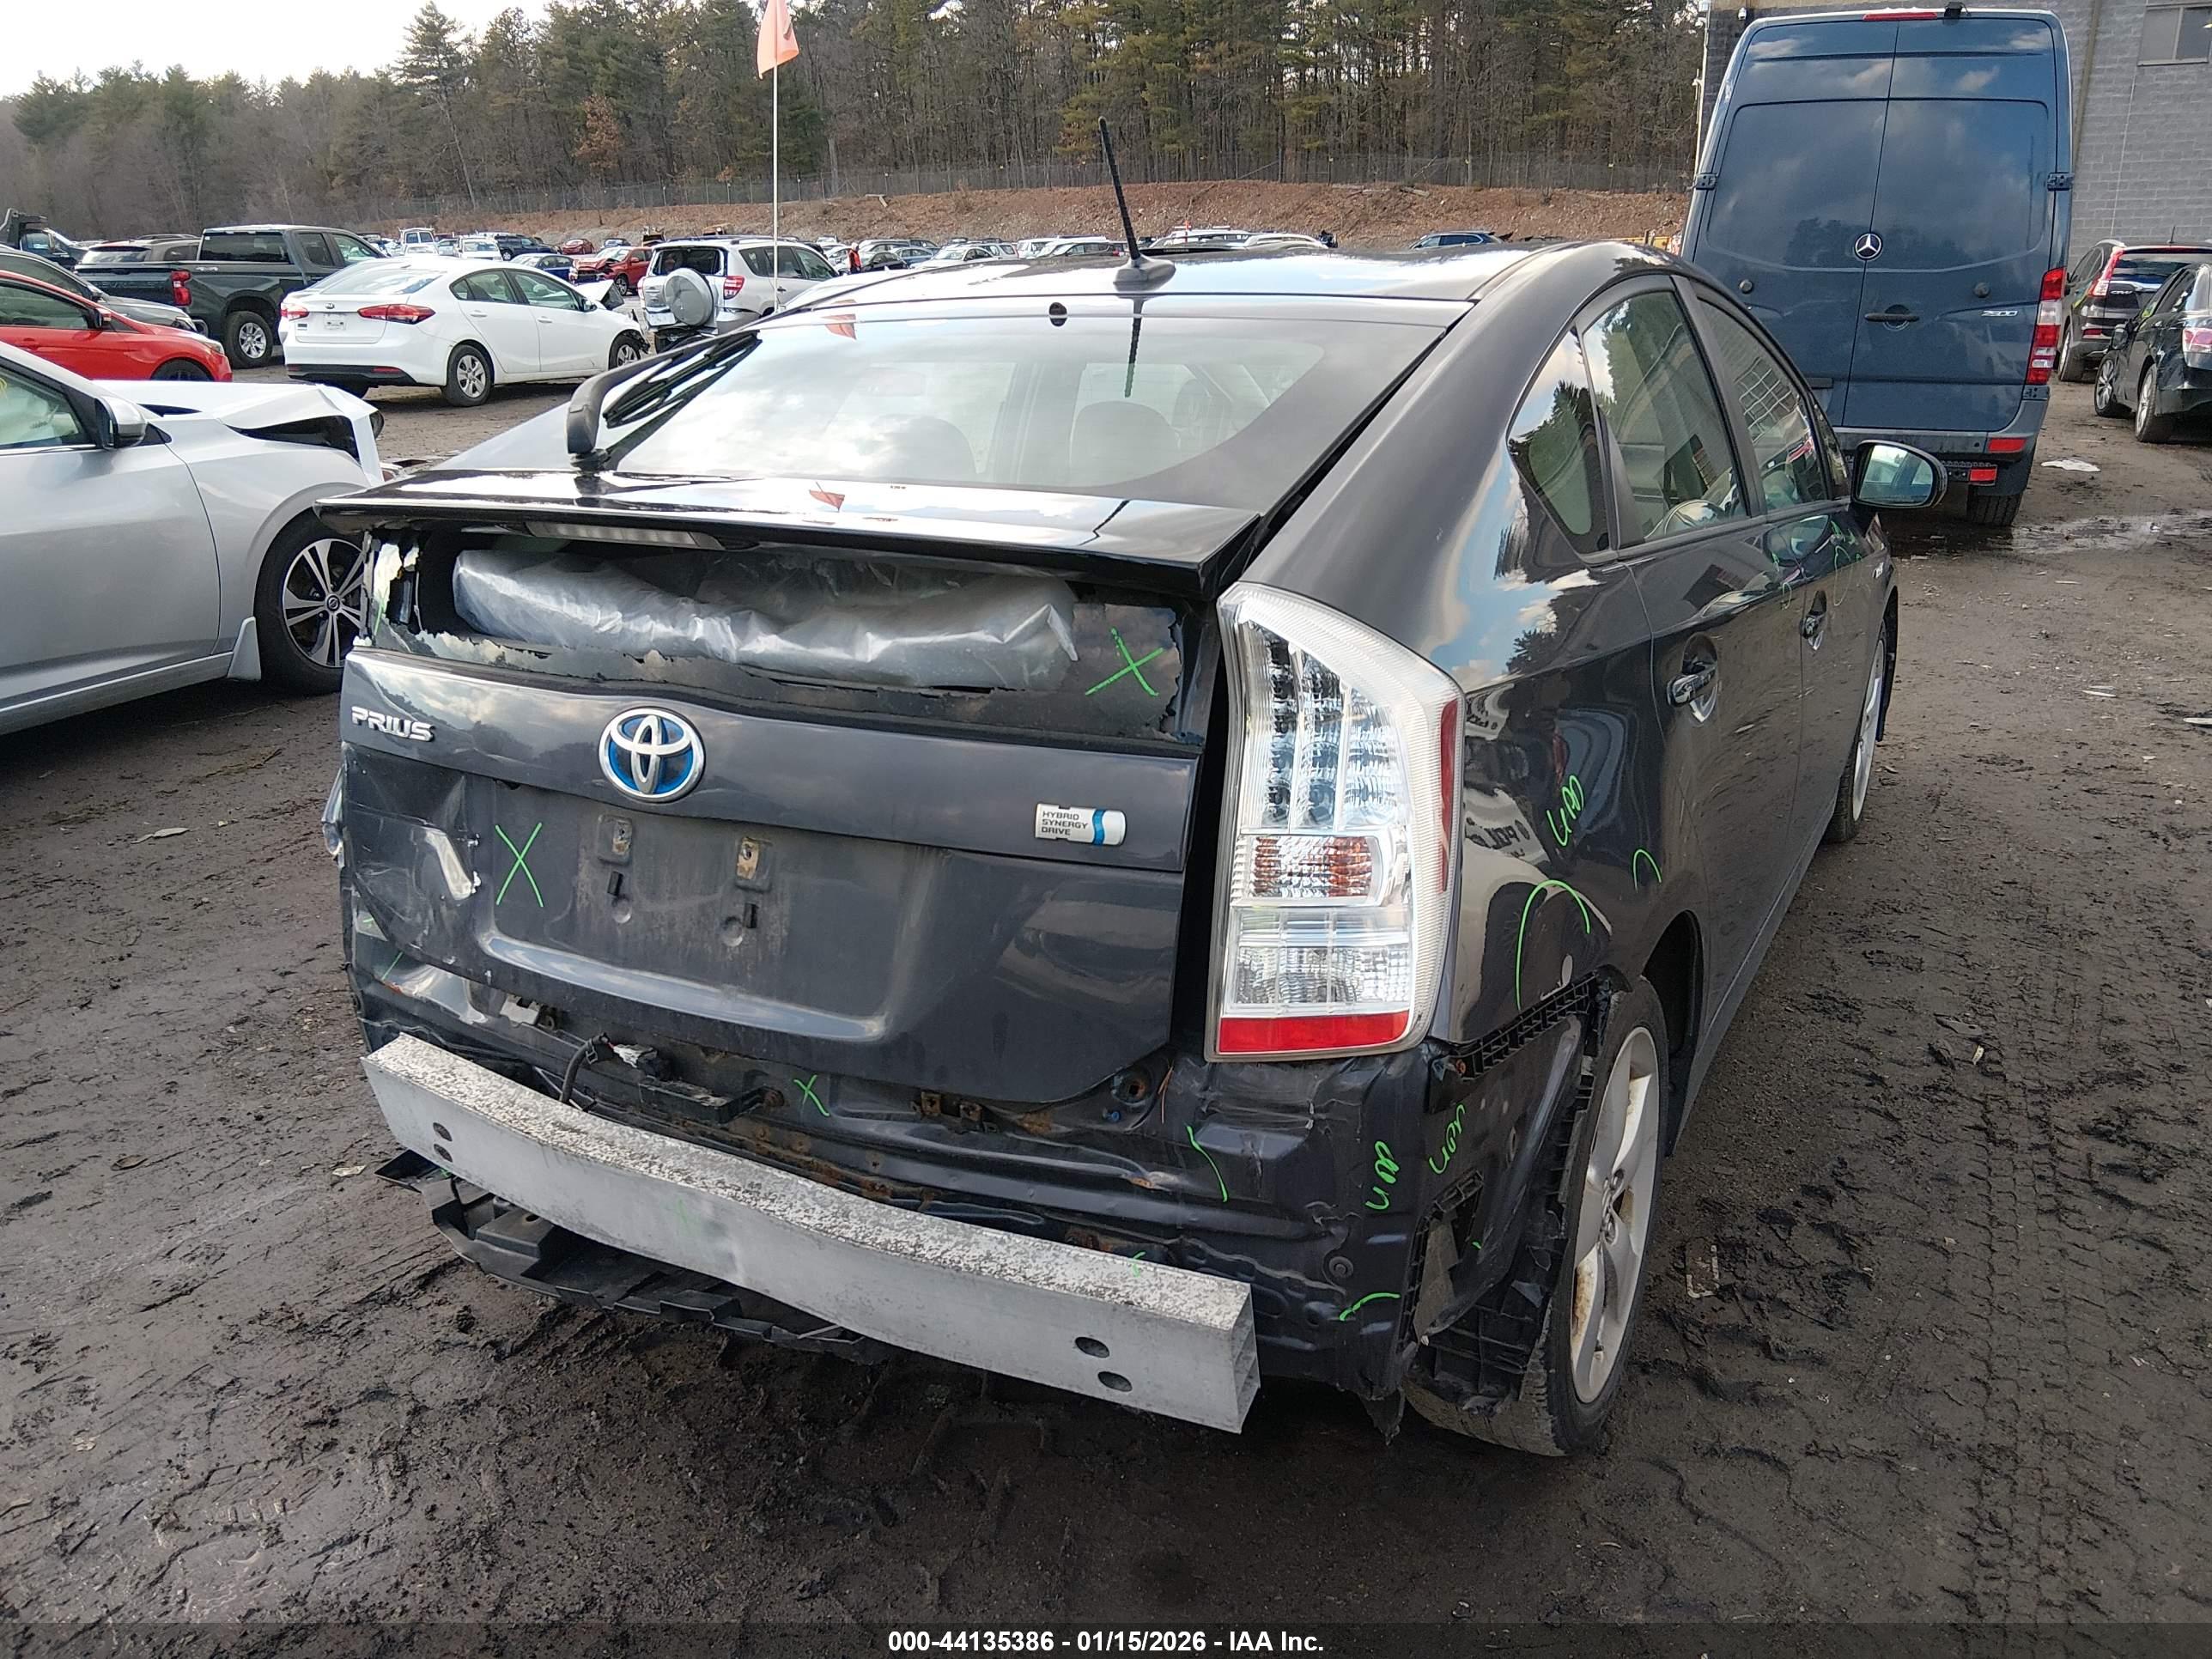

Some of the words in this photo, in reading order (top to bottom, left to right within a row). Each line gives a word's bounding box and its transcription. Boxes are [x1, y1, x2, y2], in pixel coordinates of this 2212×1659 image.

[351, 706, 434, 742] PRIUS
[1042, 810, 1080, 821] HYBRID
[1042, 818, 1089, 830] SYNERGY
[1041, 826, 1072, 836] DRIVE
